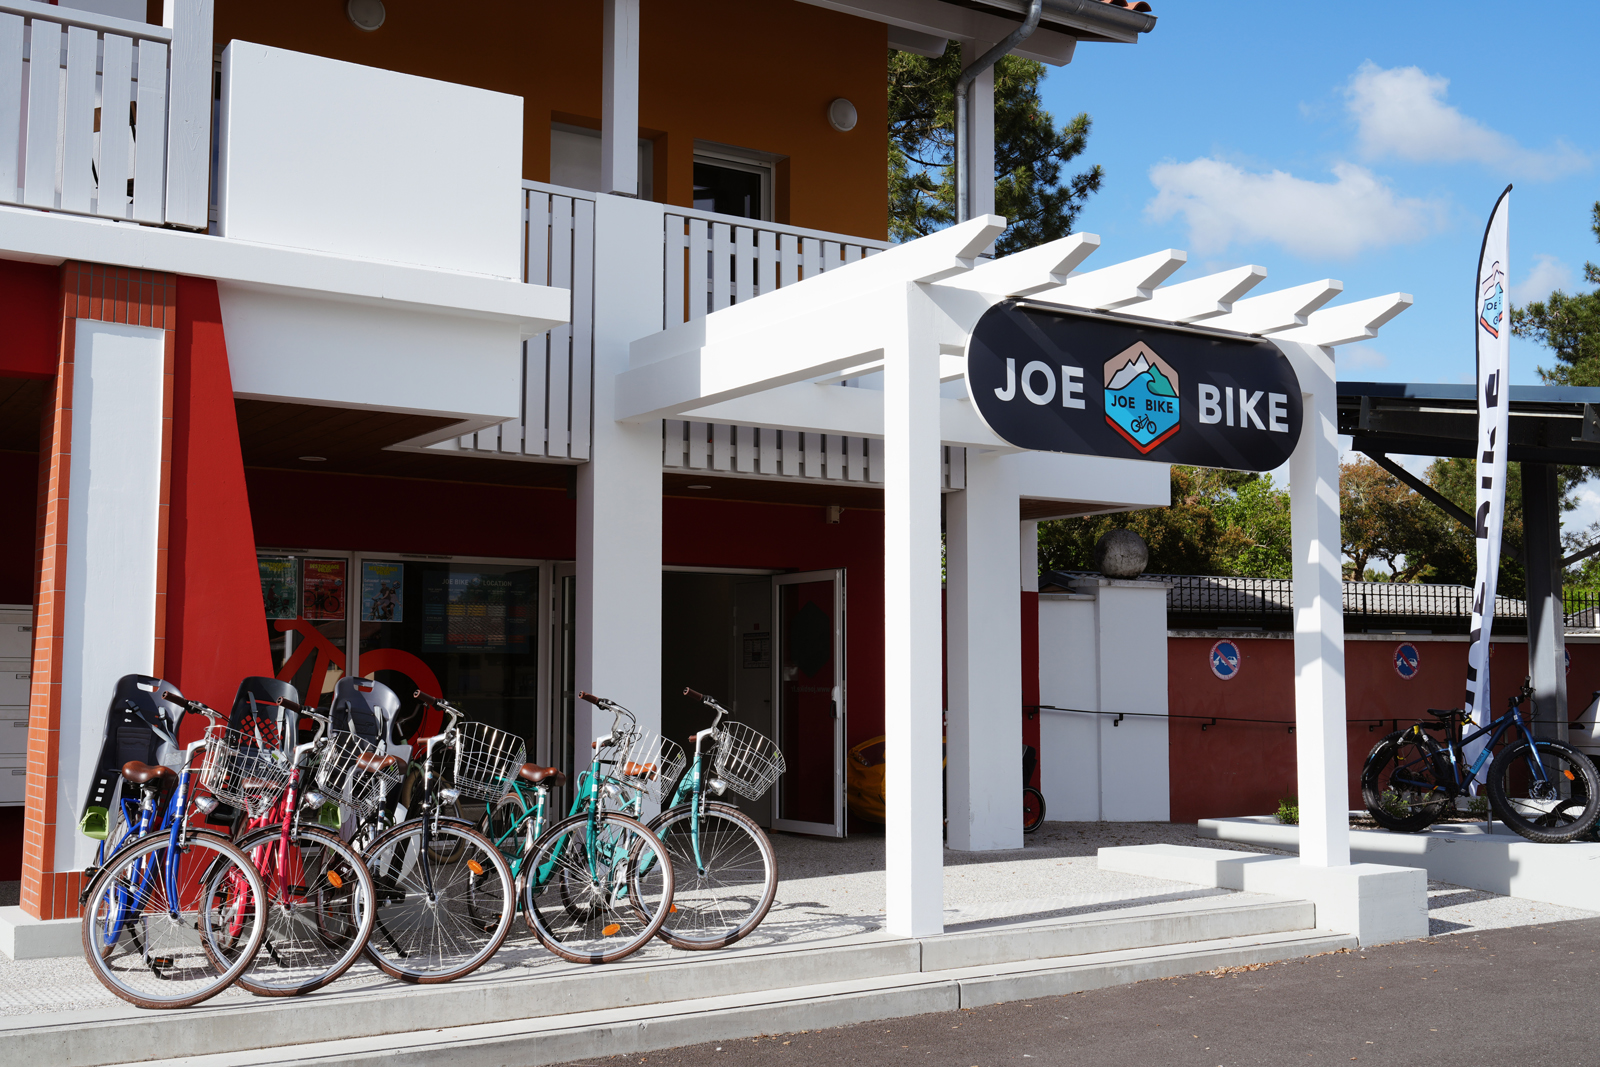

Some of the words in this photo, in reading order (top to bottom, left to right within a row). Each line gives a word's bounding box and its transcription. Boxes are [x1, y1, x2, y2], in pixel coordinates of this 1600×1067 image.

[1486, 301, 1498, 311] OE
[993, 357, 1086, 410] JOE
[1197, 382, 1289, 433] BIKE
[1110, 394, 1136, 410] JOE
[1145, 399, 1174, 414] BIKE
